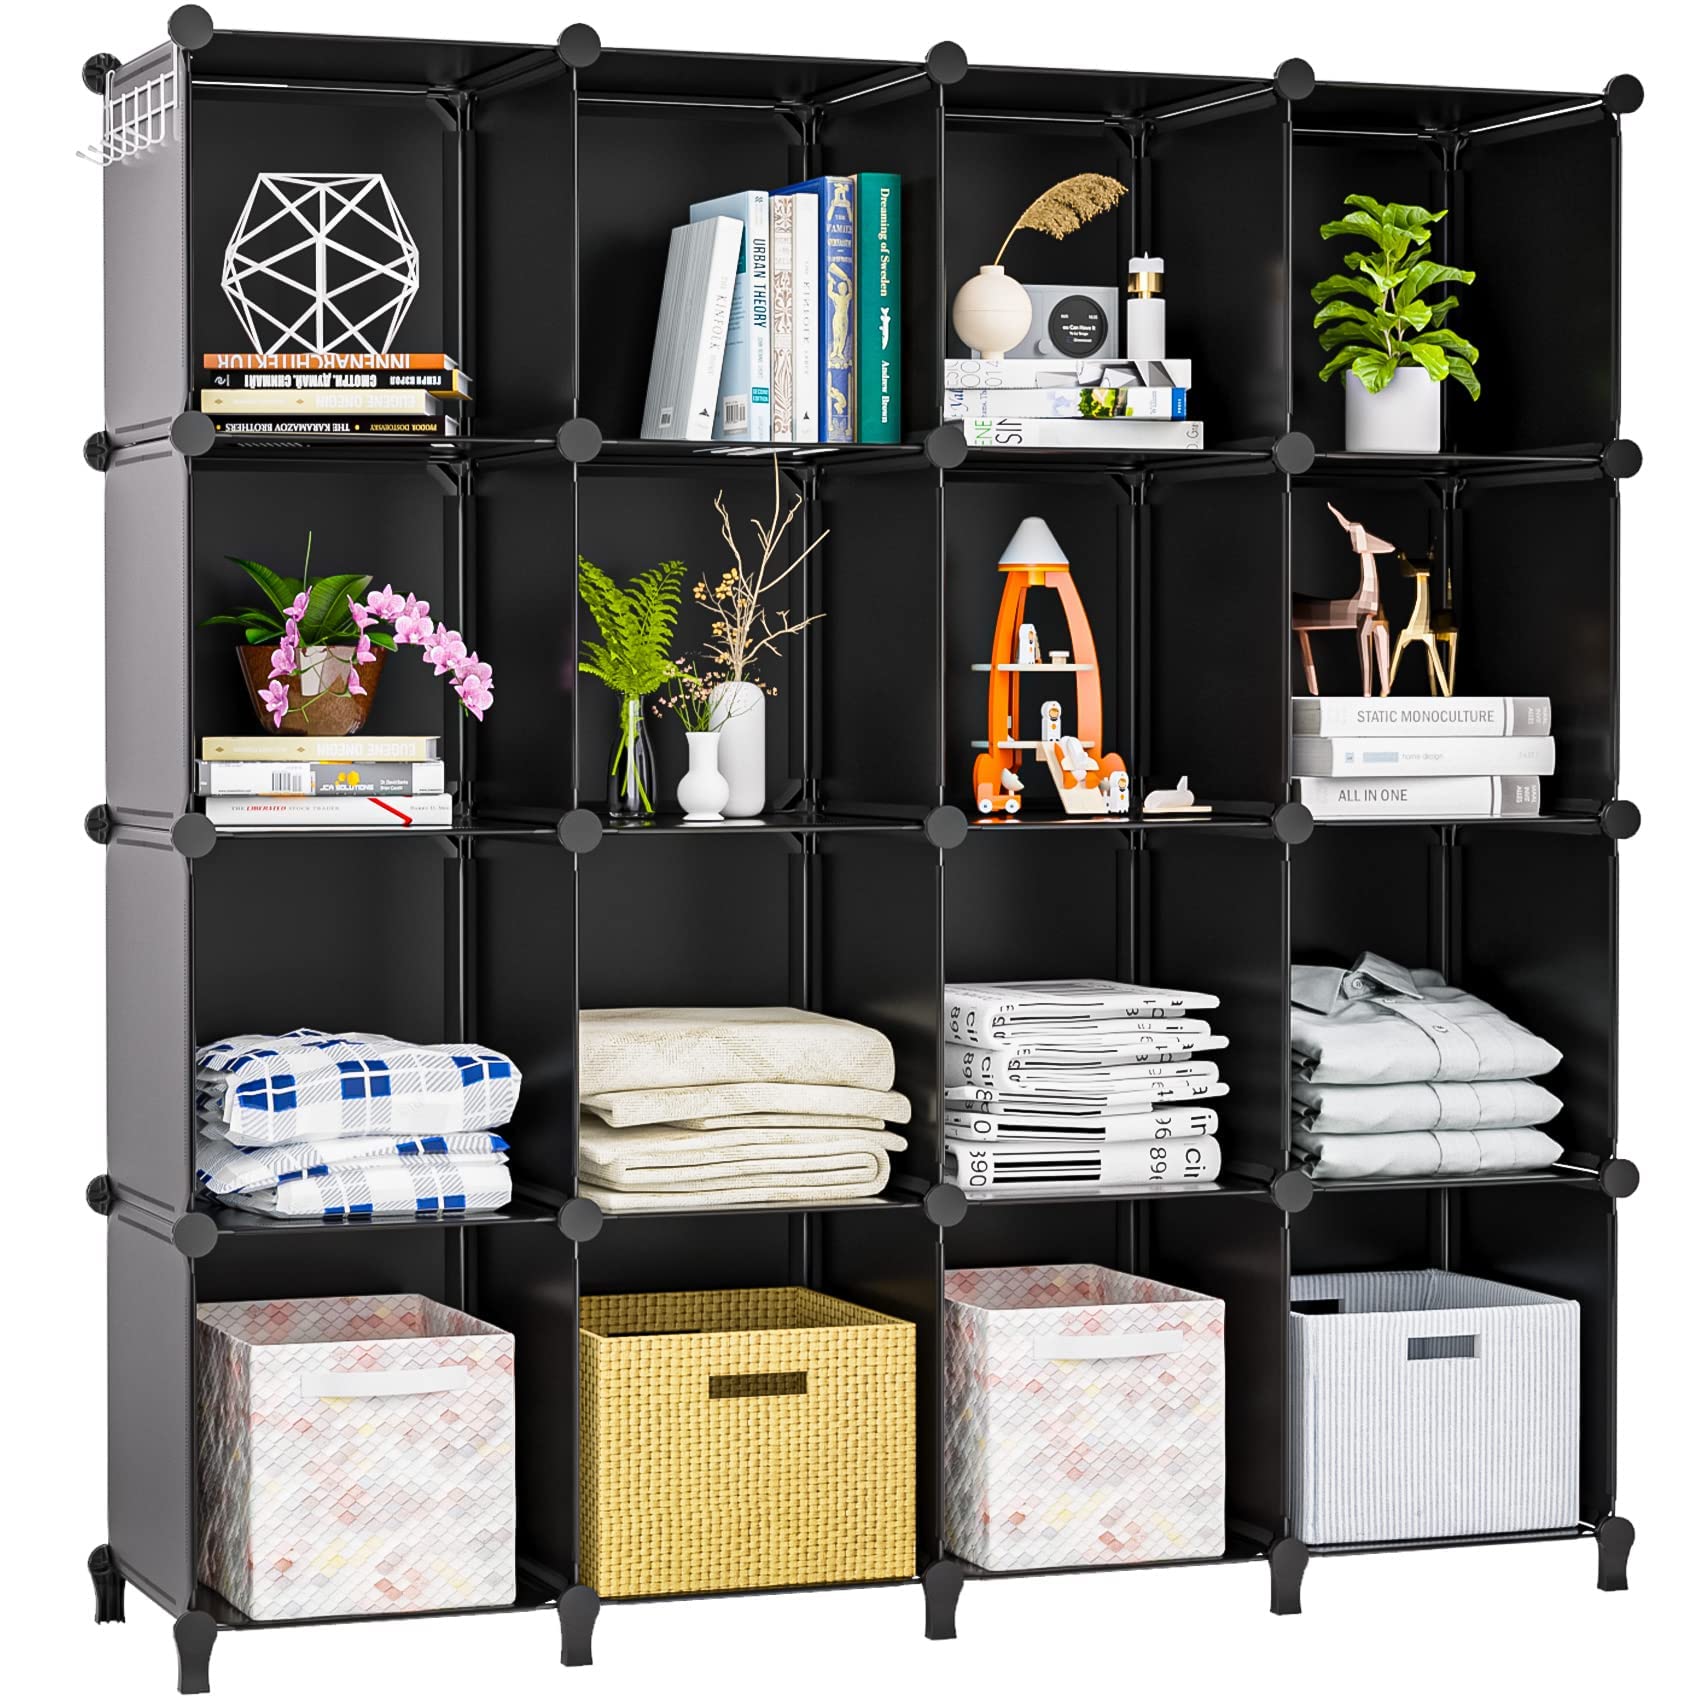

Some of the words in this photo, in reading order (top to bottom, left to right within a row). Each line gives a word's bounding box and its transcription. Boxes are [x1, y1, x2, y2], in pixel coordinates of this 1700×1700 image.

[878, 188, 890, 240] Dreaming
[880, 243, 890, 254] of
[753, 238, 766, 279] URBAN
[880, 254, 890, 297] Sweden
[754, 284, 767, 328] THEORY
[217, 354, 410, 369] INNENARCHITEKTUR
[881, 360, 890, 393] Andrew
[315, 395, 362, 408] ONEGIN
[367, 395, 416, 408] EUGENE
[881, 395, 890, 423] Brown
[225, 424, 272, 432] BROTHERS
[274, 424, 330, 432] KARAMAZOV
[331, 423, 350, 432] THE
[1357, 711, 1397, 723] STATIC
[1401, 710, 1495, 723] MONOCULTURE
[317, 743, 362, 756] ONEGIN
[367, 743, 416, 756] EUGENE
[1338, 789, 1360, 801] ALL
[1364, 789, 1377, 801] IN
[1381, 789, 1407, 801] ONE
